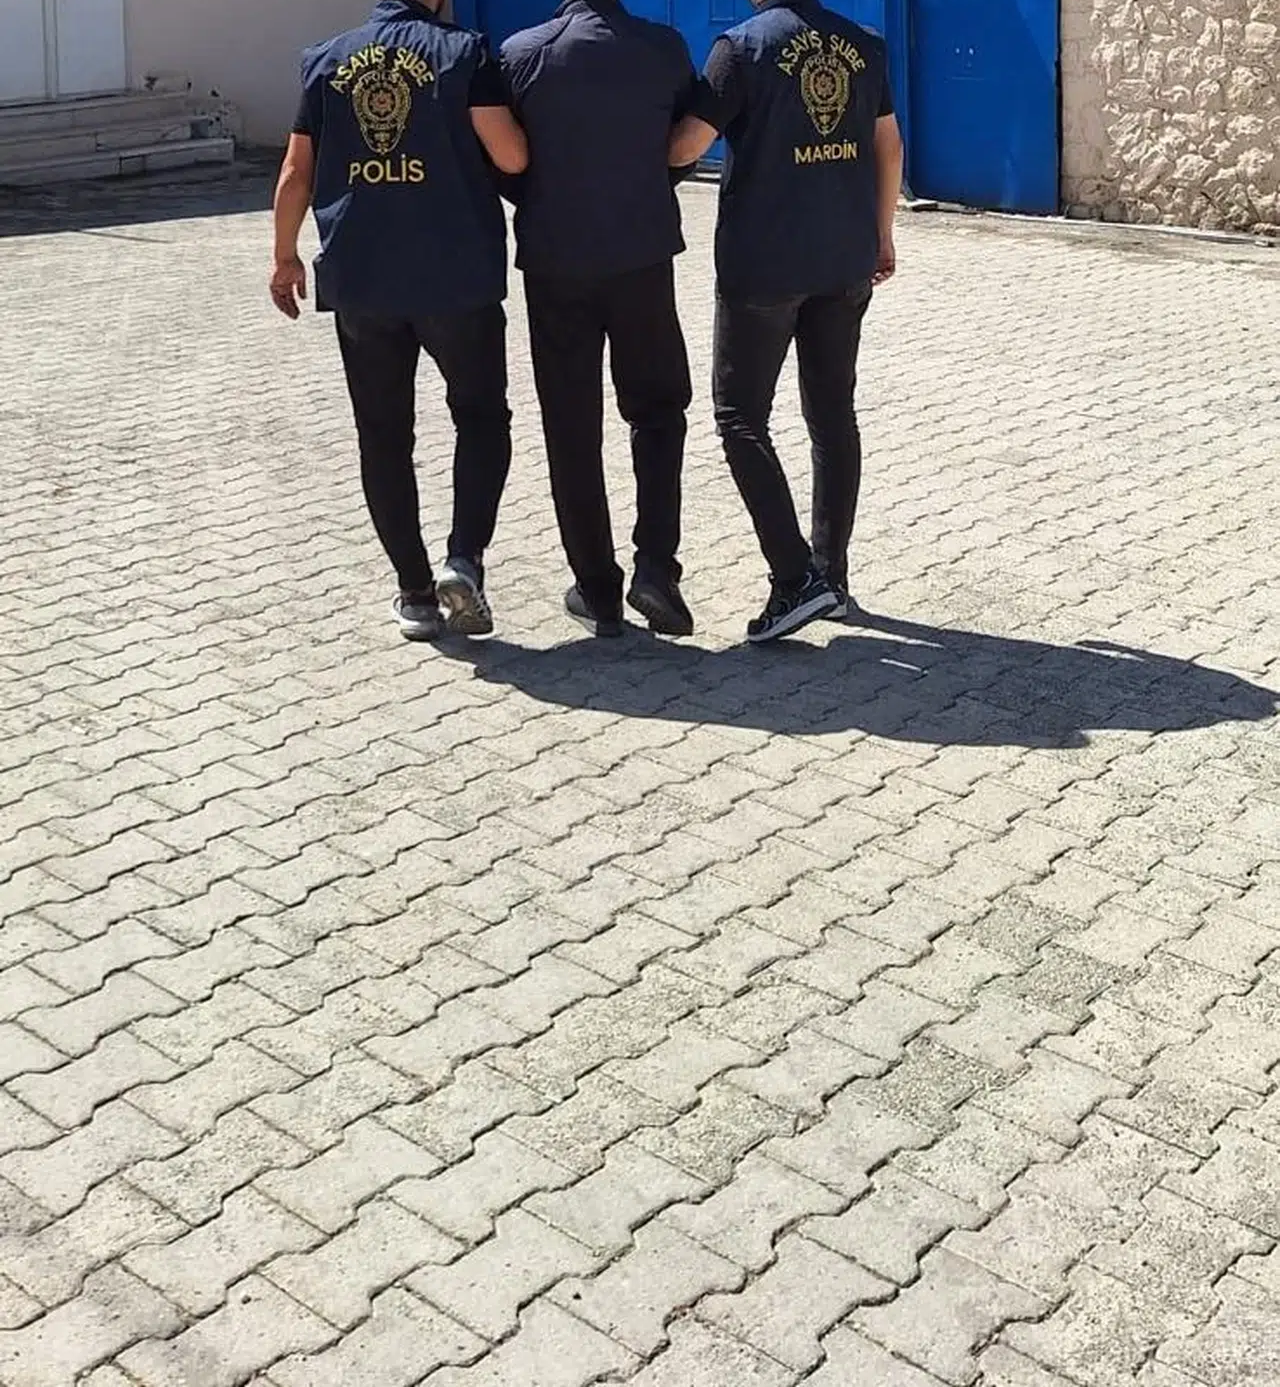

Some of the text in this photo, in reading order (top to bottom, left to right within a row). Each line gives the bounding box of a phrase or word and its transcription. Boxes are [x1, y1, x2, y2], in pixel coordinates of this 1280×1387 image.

[392, 47, 435, 87] ŞUBE
[794, 139, 858, 164] MARDİN
[348, 153, 425, 185] POLİS
